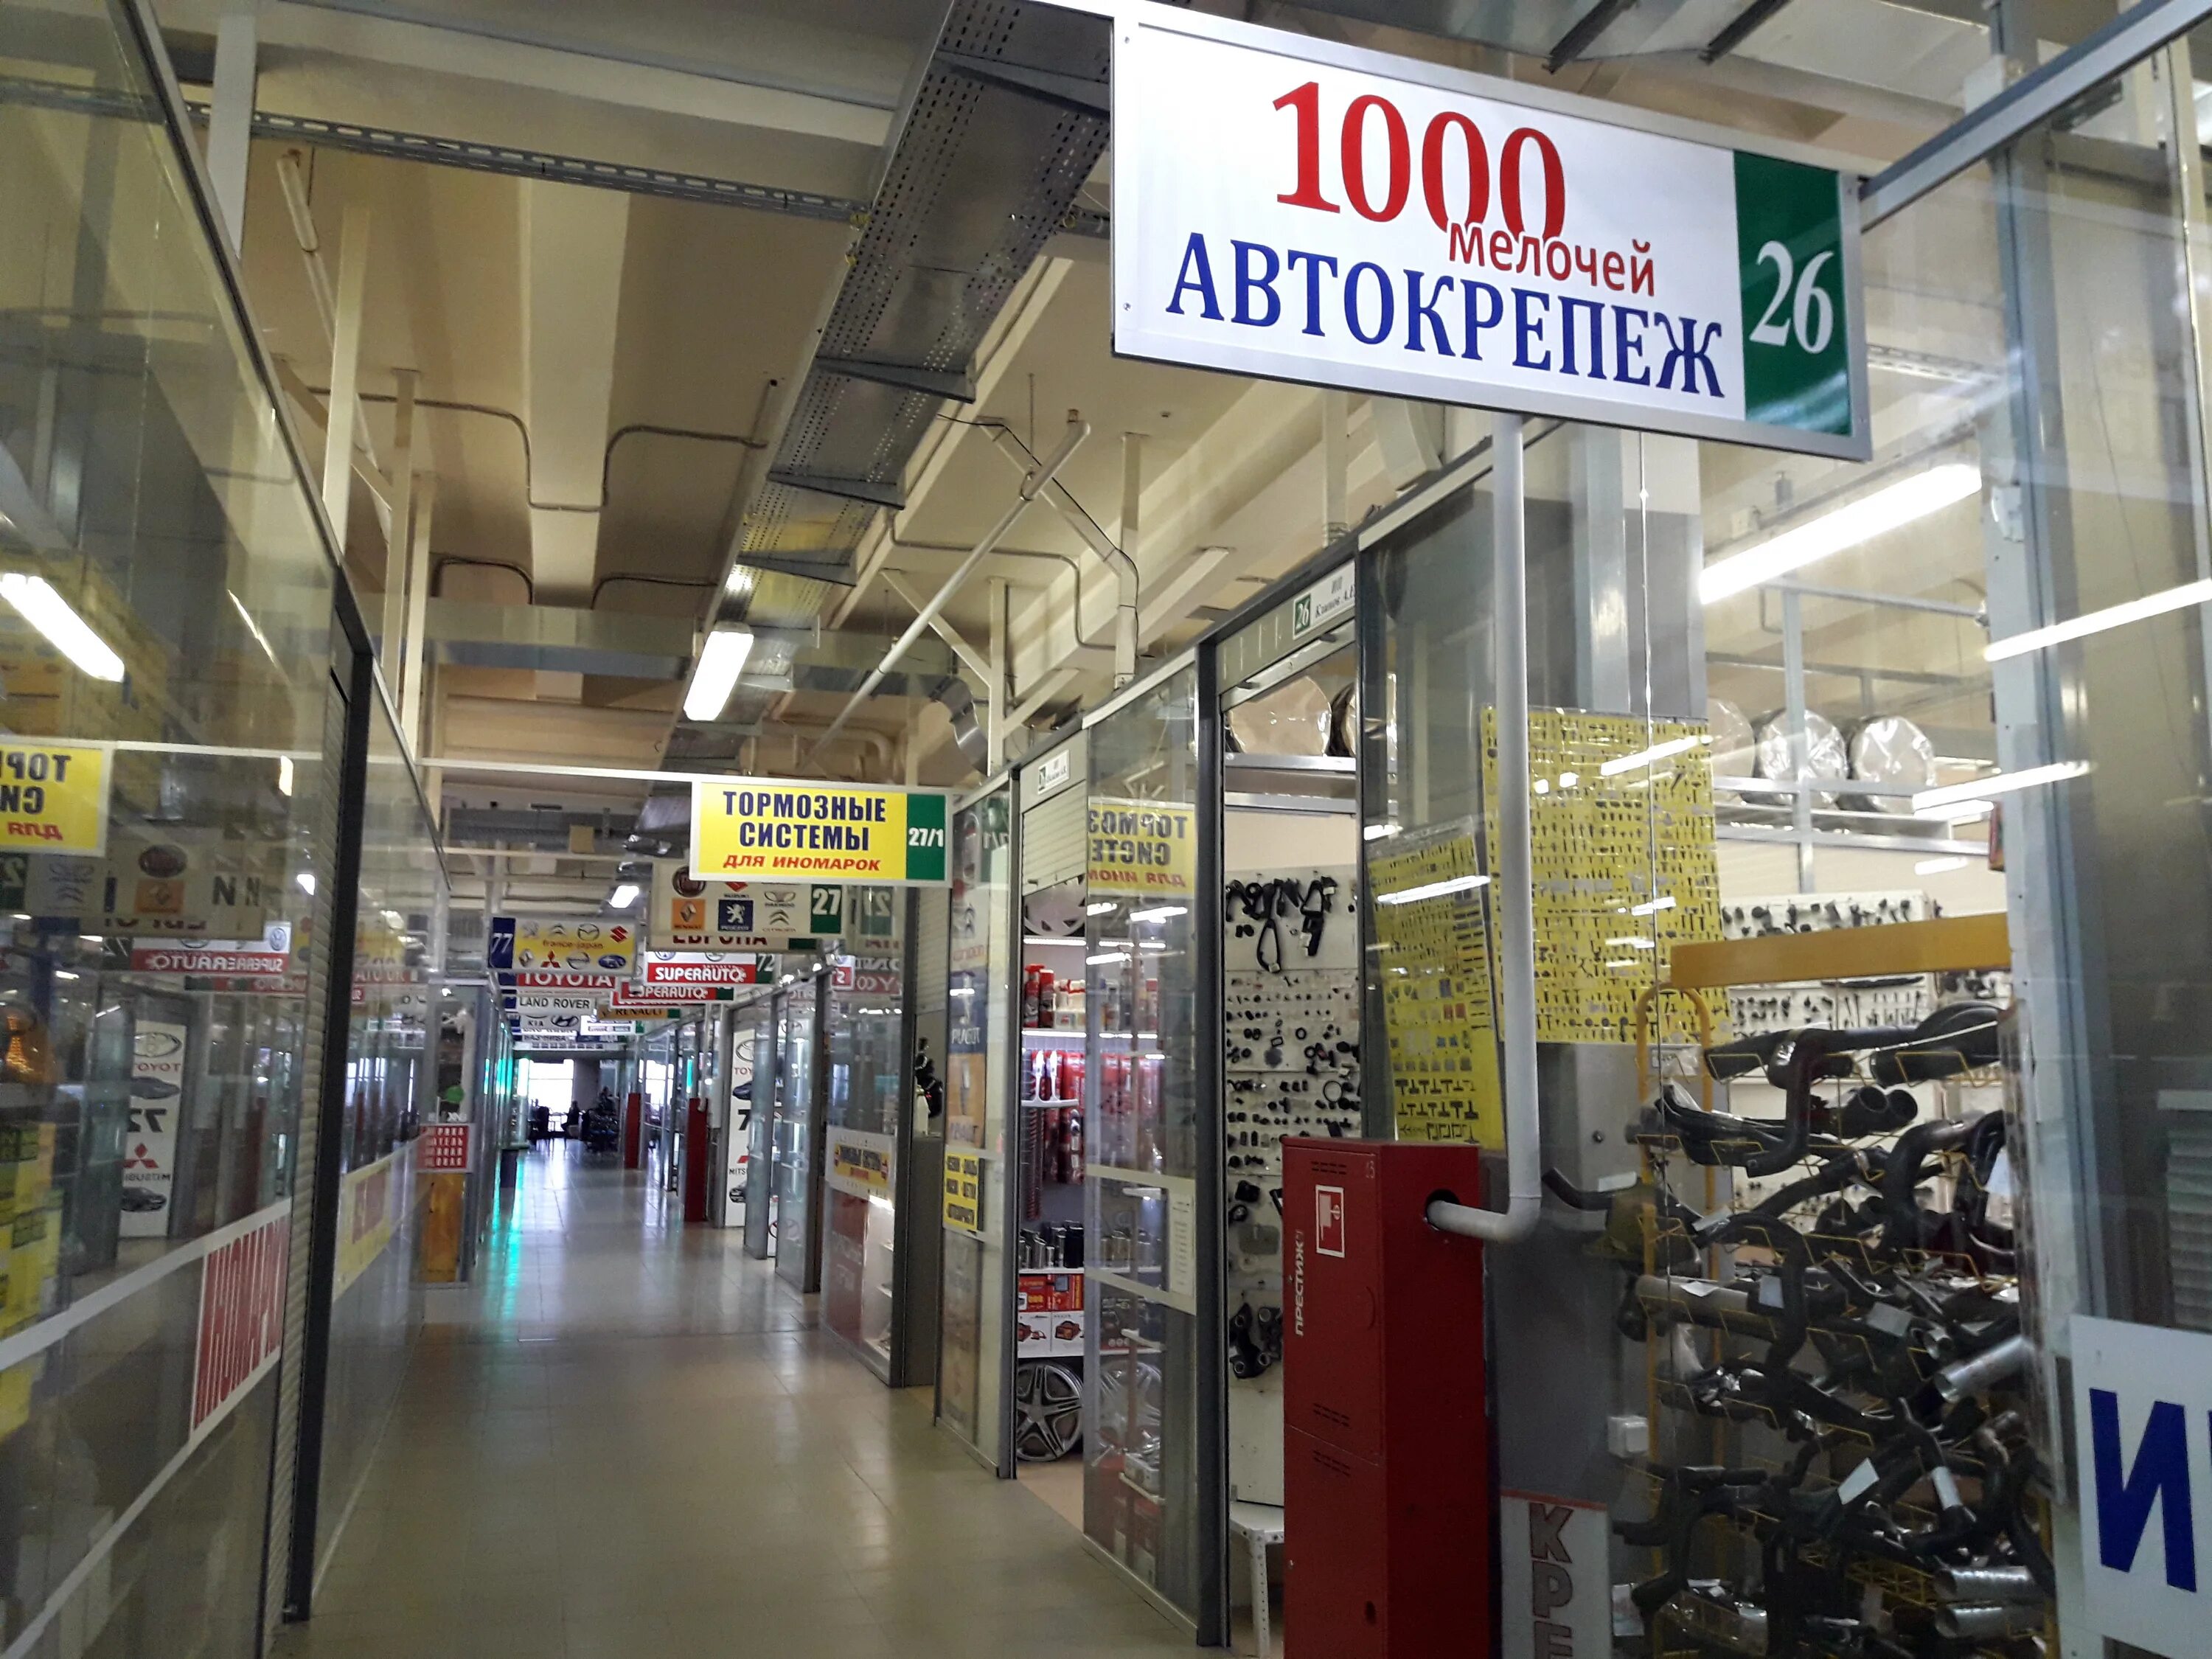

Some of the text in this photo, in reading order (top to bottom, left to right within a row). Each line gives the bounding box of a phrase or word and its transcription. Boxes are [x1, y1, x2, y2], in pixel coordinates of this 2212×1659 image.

[1273, 81, 1565, 244] 1000
[1447, 221, 1655, 296] мелочей
[1749, 240, 1834, 354] 26
[1165, 232, 1725, 399] АВТОКРЕПЕЖ
[723, 790, 886, 822] ТОРМОЗНЫЕ
[739, 822, 869, 851] СИСТЕМЫ
[908, 827, 945, 847] 27/1
[813, 888, 841, 916] 27
[490, 932, 514, 954] 77
[524, 973, 613, 988] TOYOTA
[655, 965, 747, 983] SUPERAUTO
[519, 998, 590, 1009] LAND ROVER
